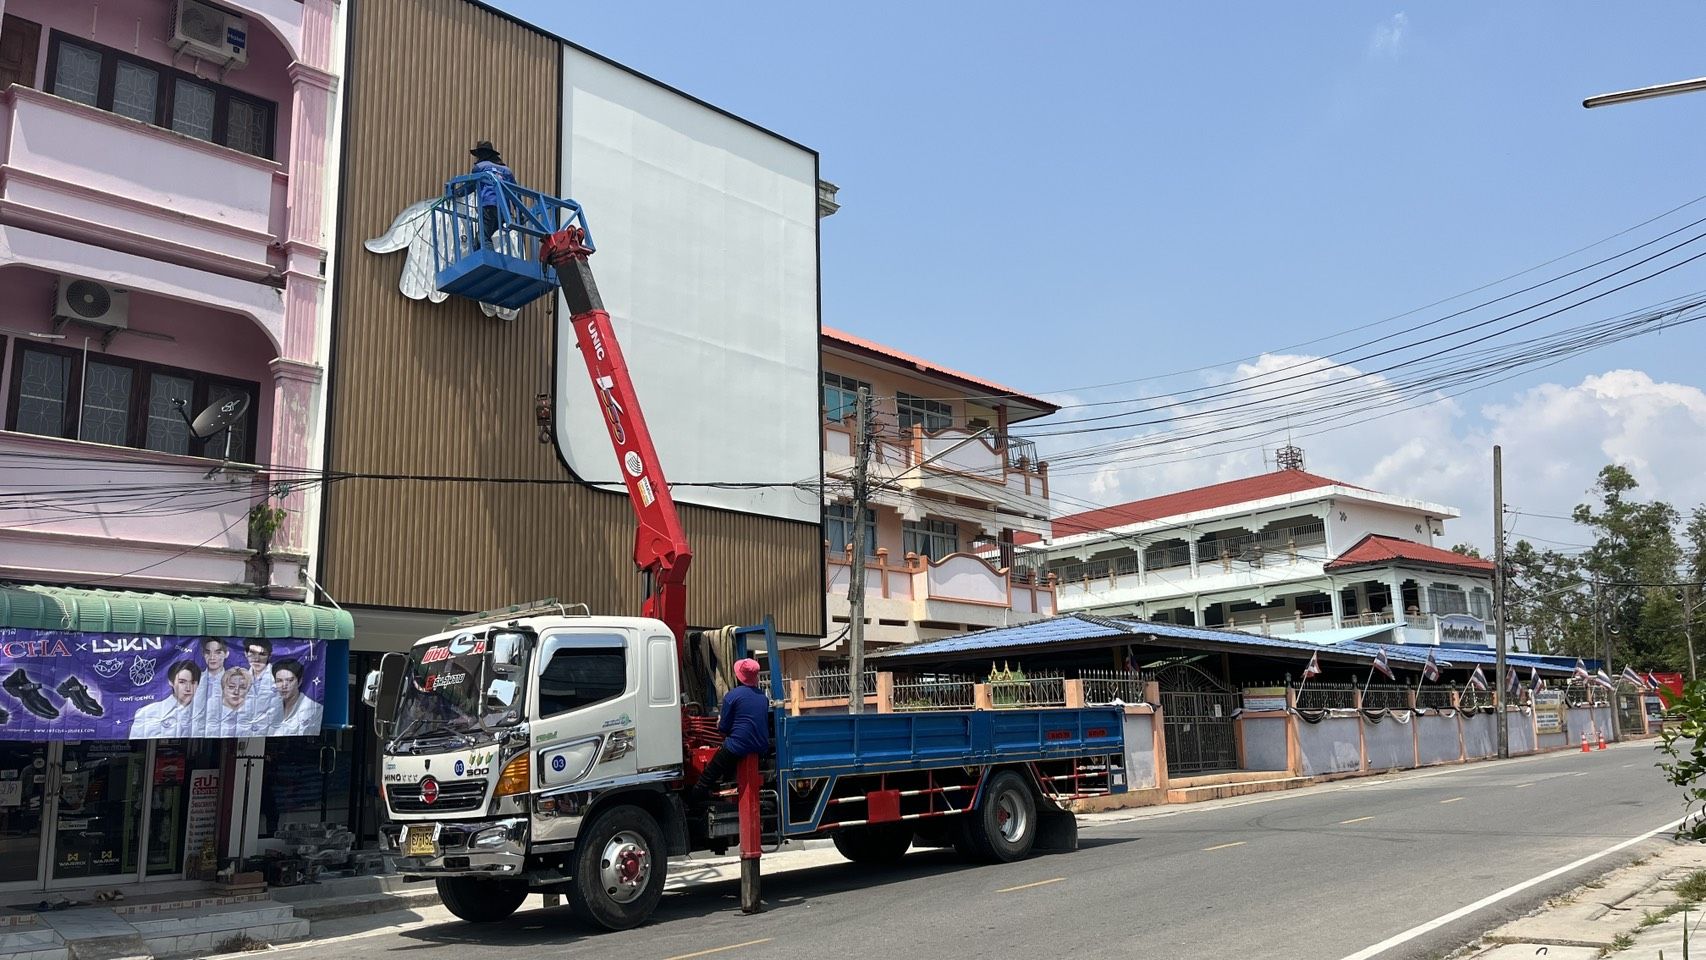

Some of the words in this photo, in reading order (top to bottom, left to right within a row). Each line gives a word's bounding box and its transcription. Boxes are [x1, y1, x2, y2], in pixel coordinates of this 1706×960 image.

[588, 321, 605, 360] UNIC
[0, 639, 72, 658] CHA
[92, 637, 162, 653] LYKN
[455, 763, 464, 773] 03
[553, 760, 565, 768] 03
[467, 767, 489, 777] 500
[412, 833, 433, 846] 67-152
